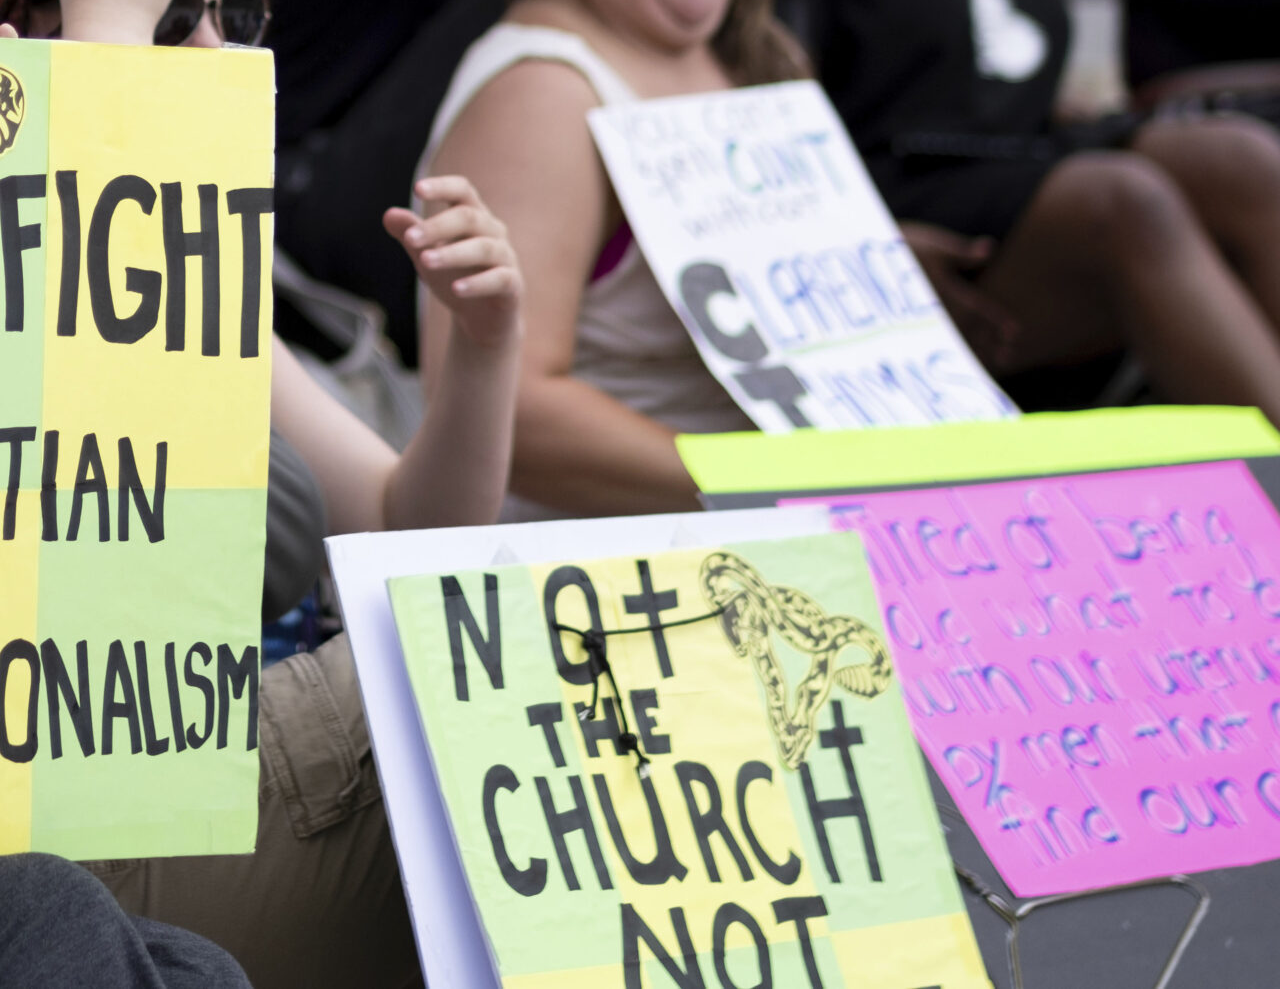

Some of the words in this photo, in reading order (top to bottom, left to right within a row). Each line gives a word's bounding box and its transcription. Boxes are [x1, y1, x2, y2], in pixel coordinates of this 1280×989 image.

[527, 687, 672, 768] THE
[481, 700, 883, 897] CHURCH
[620, 895, 829, 989] NOT
